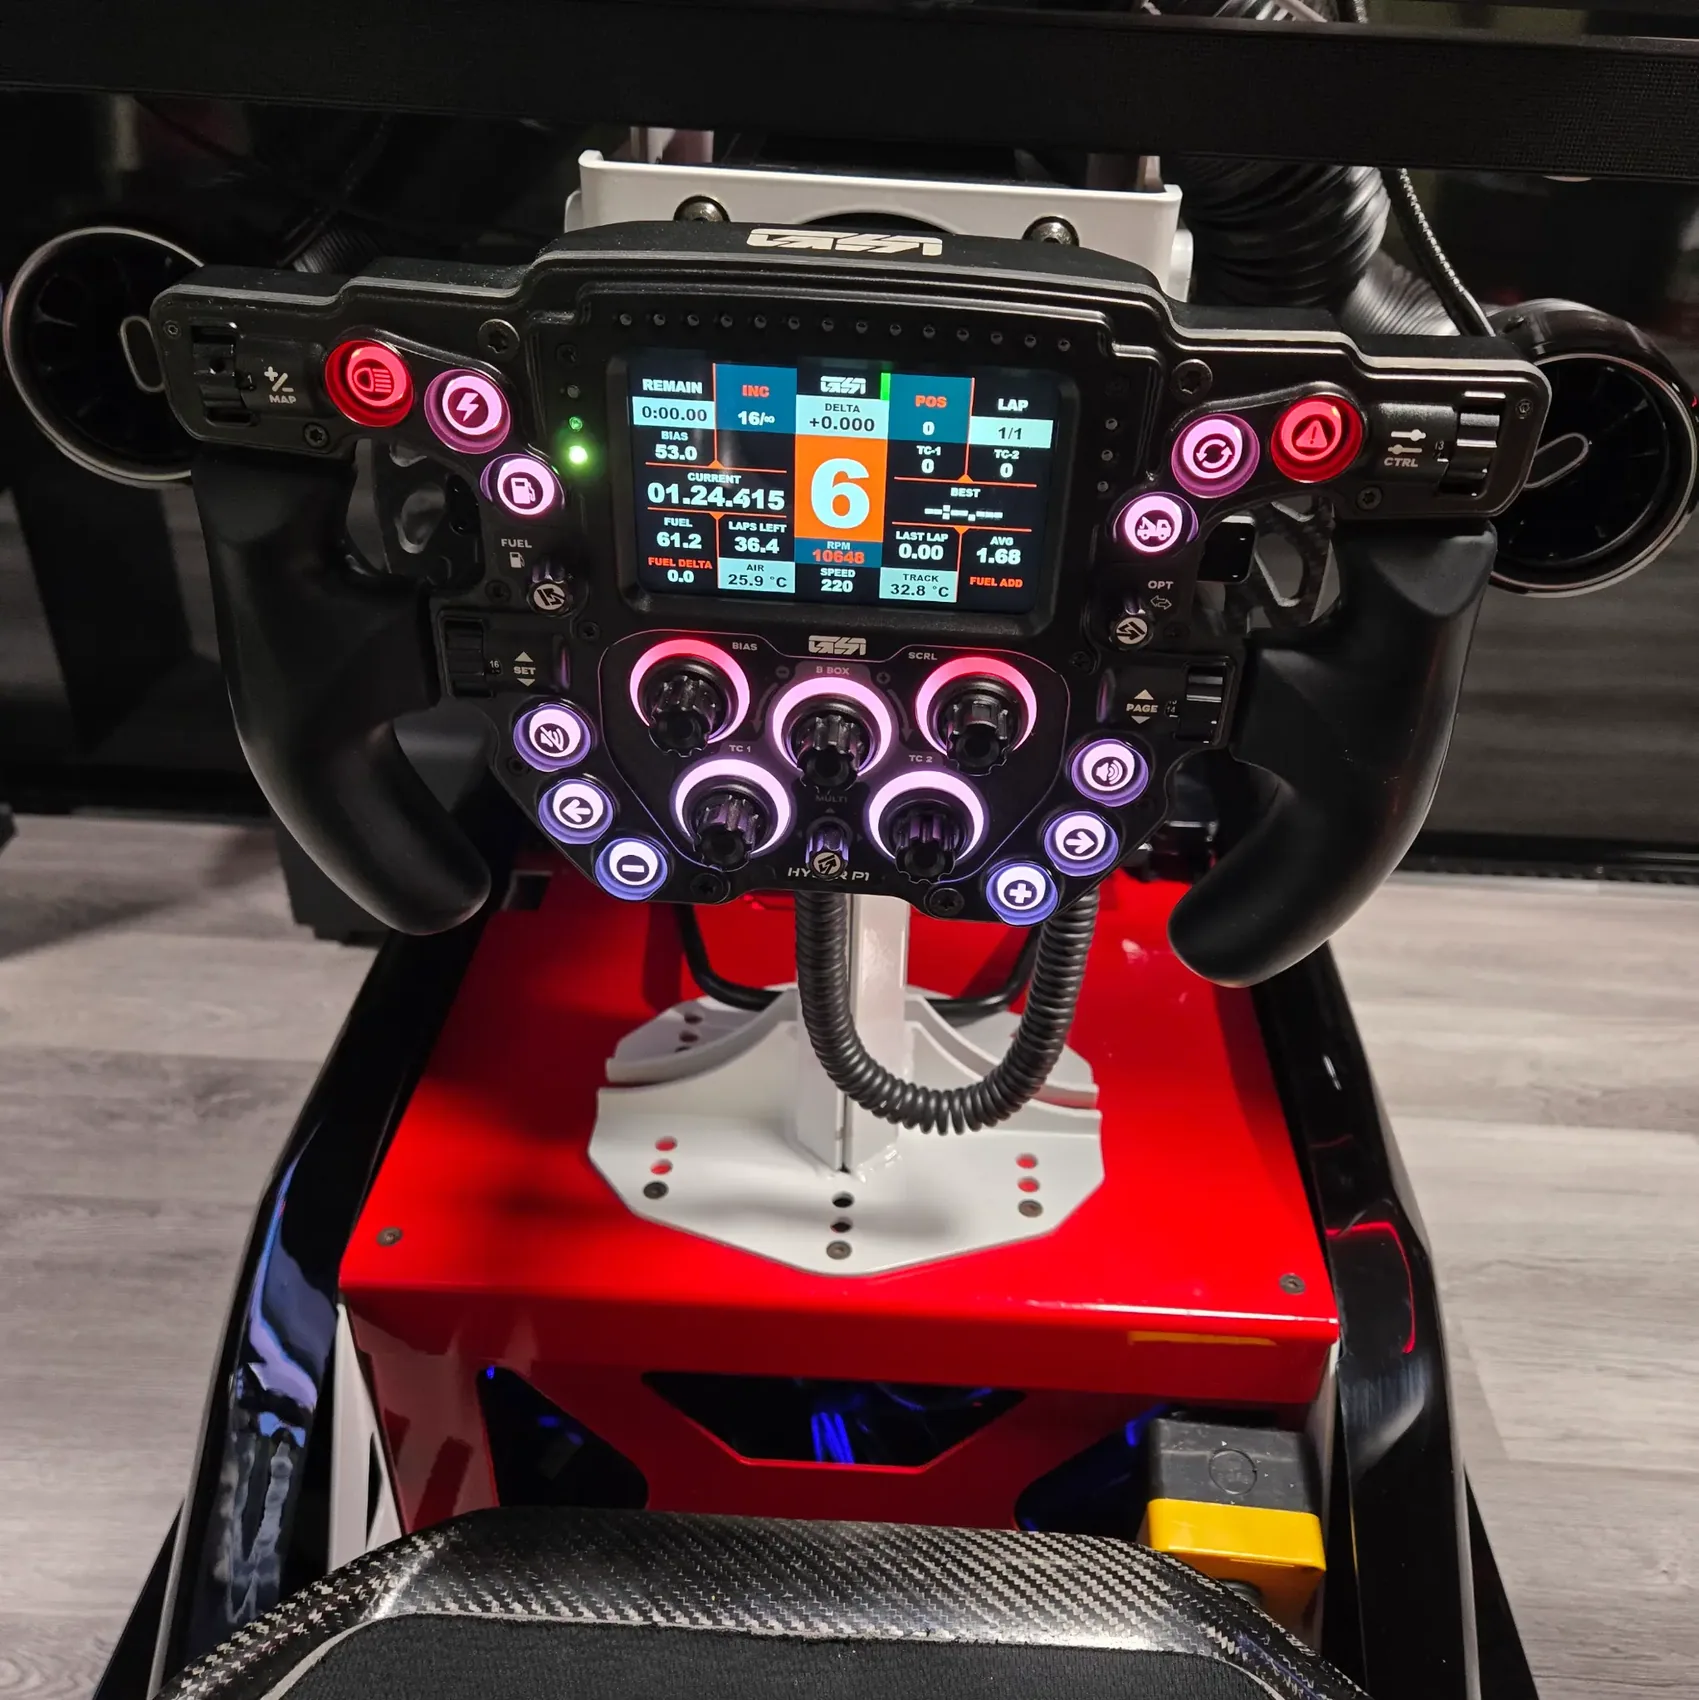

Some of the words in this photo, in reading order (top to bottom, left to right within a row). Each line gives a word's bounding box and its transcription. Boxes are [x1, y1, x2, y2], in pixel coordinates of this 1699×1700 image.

[642, 378, 702, 394] REMAIN
[742, 385, 769, 398] INC
[269, 394, 297, 404] MAP
[915, 395, 947, 408] POS
[997, 398, 1029, 412] LAP
[642, 405, 707, 422] 0:00.00
[824, 403, 860, 413] DELTA
[809, 416, 875, 432] +0.000
[922, 421, 935, 436] 0
[661, 431, 688, 442] BIAS
[998, 427, 1022, 440] 1/1
[655, 444, 698, 461] 53.0
[916, 445, 941, 456] TC-1
[994, 448, 1020, 460] TC-2
[921, 458, 935, 474] 0
[1384, 457, 1418, 468] CTRL
[999, 462, 1014, 478] 0
[687, 472, 741, 484] CURRENT
[811, 457, 870, 529] 6
[950, 487, 981, 498] BEST
[664, 517, 693, 528] FUEL
[728, 520, 757, 532] LAPS
[759, 522, 787, 533] LEFT
[656, 532, 702, 549] 61.2
[895, 530, 925, 541] LAST
[926, 532, 949, 542] LAP
[990, 536, 1014, 546] AVG
[501, 538, 532, 548] FUEL
[734, 536, 779, 554] 36.4
[826, 541, 851, 550] RPM
[898, 543, 944, 561] 0.00
[976, 547, 1021, 565] 1.68
[648, 557, 676, 567] FUEL
[678, 558, 712, 570] DELTA
[746, 563, 764, 572] AIR
[667, 569, 694, 583] 0.0
[820, 567, 856, 578] SPEED
[903, 573, 939, 582] TRACK
[728, 574, 764, 586] 25.9
[821, 579, 853, 593] 220
[970, 576, 997, 587] FUEL
[999, 578, 1023, 588] ADD
[1147, 580, 1174, 590] OPT
[890, 583, 926, 596] 32.8
[732, 641, 758, 651] BIAS
[908, 651, 937, 661] SCRL
[513, 666, 536, 675] SET
[826, 666, 850, 675] BOX
[1126, 703, 1158, 713] PAGE
[729, 744, 744, 752] TC
[909, 754, 924, 762] TC
[925, 755, 933, 763] 2
[815, 794, 848, 803] MULTI
[787, 867, 847, 880] HYR
[851, 870, 870, 881] P1
